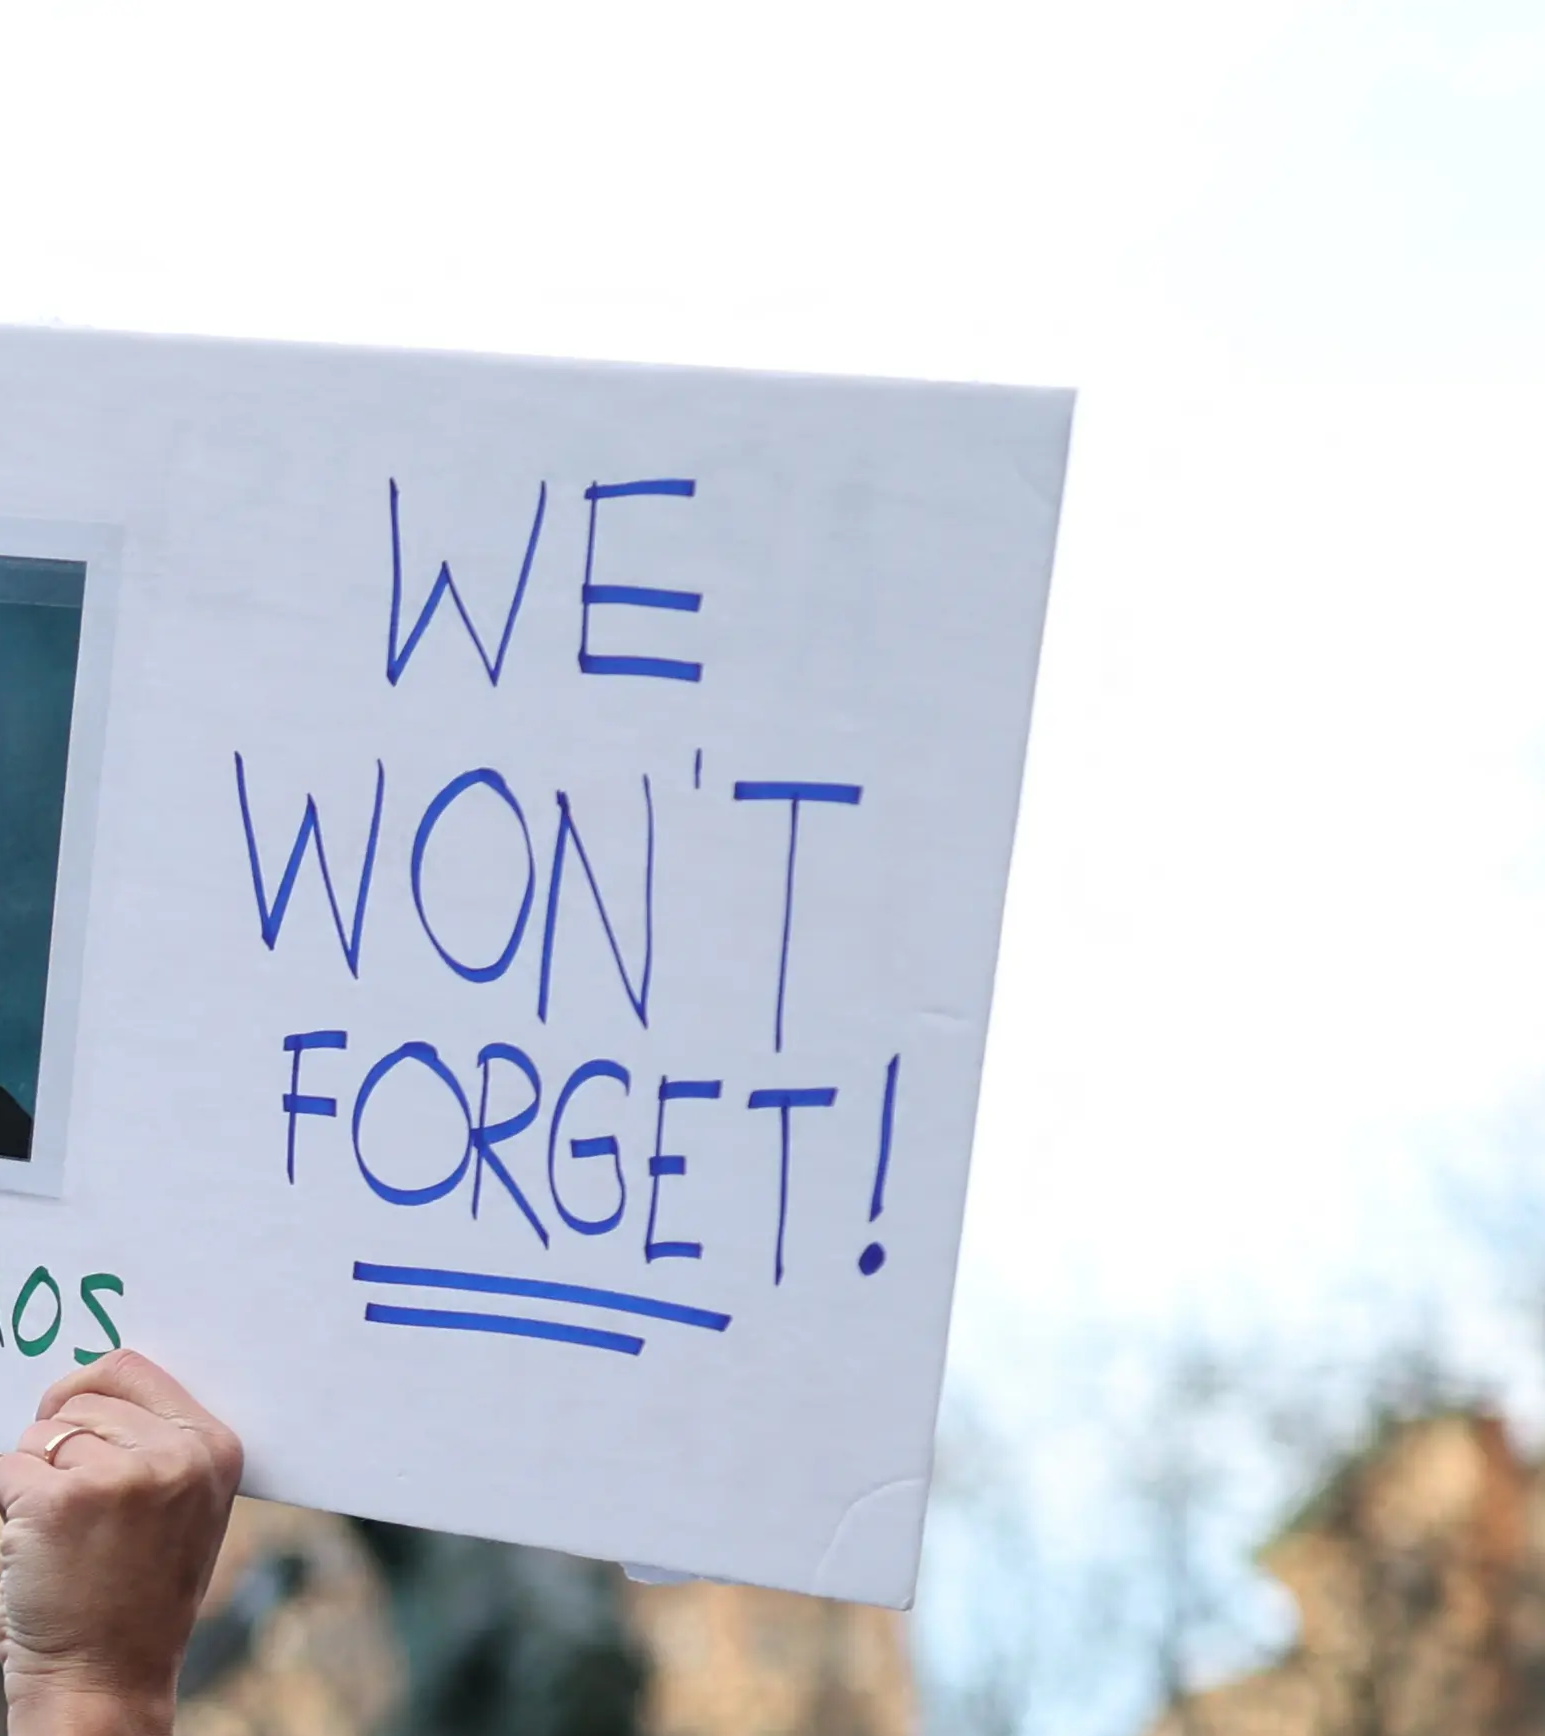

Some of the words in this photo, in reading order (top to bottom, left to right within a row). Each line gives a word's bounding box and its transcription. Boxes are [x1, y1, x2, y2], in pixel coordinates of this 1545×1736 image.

[385, 477, 703, 688] WE
[234, 750, 863, 1053] WON'T
[281, 1029, 900, 1287] FORGET!
